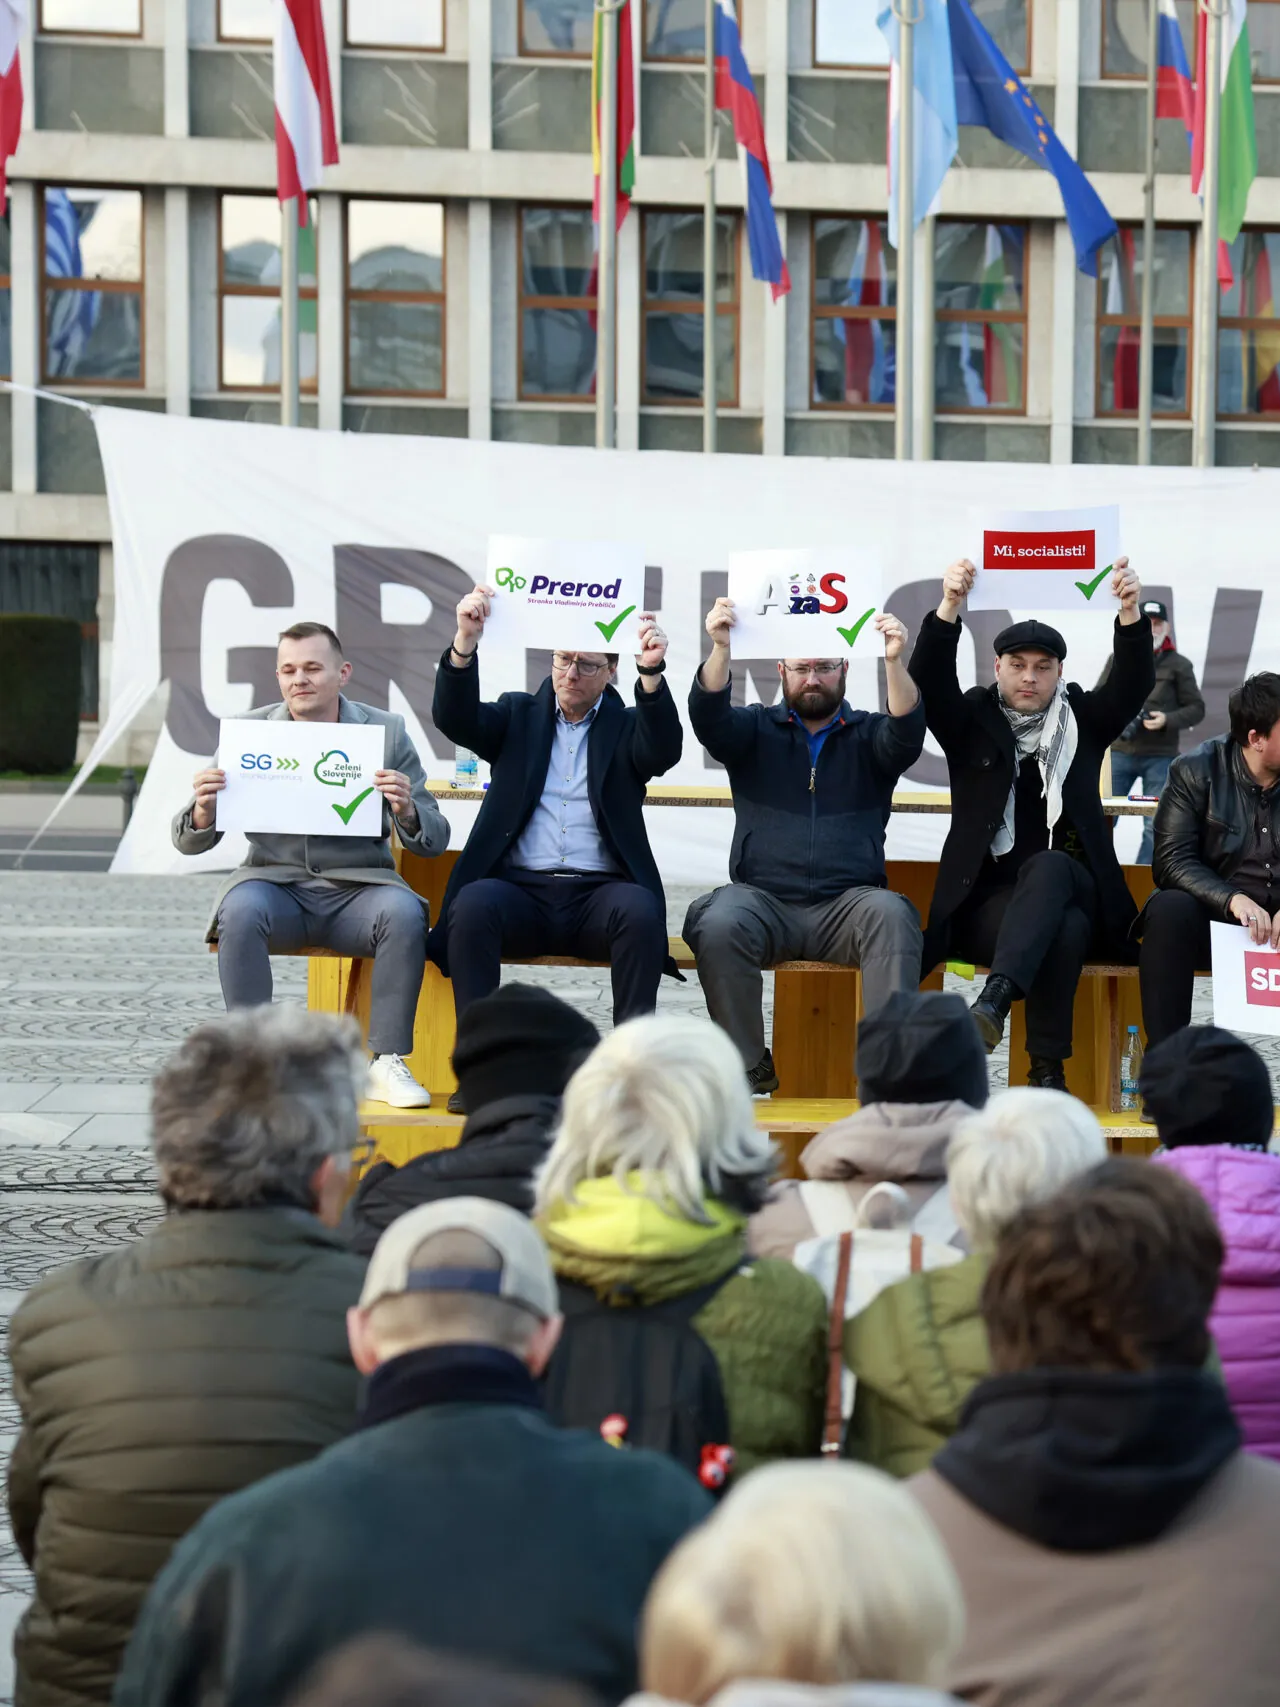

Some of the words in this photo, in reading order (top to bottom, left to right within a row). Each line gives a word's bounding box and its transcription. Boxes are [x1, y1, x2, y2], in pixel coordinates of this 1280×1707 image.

[993, 545, 1015, 558] Mi,
[1018, 544, 1086, 557] socialisti!
[529, 575, 622, 599] Prerod
[527, 597, 553, 605] Stranka
[554, 599, 587, 608] Vladimirja
[240, 753, 272, 770] SG
[334, 763, 361, 771] Zeleni
[322, 769, 362, 780] Slovenije
